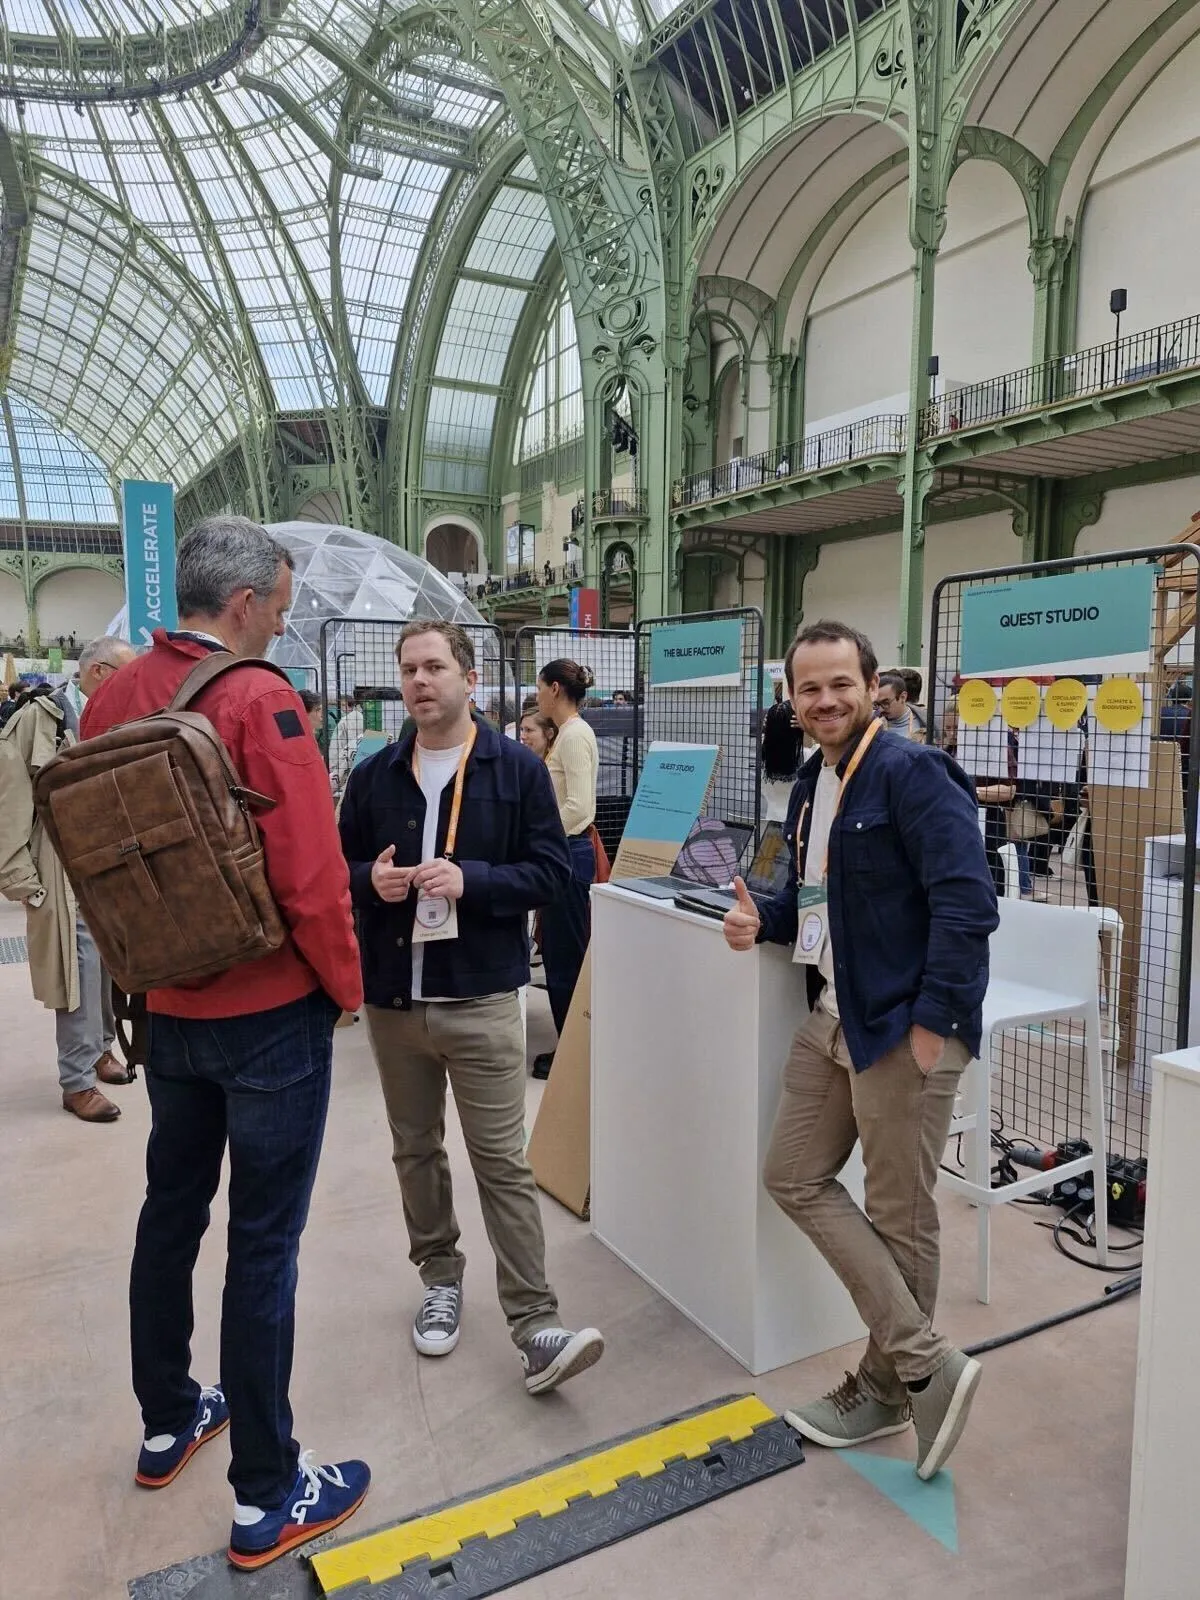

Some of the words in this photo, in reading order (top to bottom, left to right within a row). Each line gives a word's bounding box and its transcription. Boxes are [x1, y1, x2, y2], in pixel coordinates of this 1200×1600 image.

[142, 503, 161, 622] ACCELERATE
[1000, 611, 1043, 627] QUEST
[1045, 606, 1100, 624] STUDIO
[663, 649, 676, 658] THE
[676, 648, 692, 657] BLUE
[693, 645, 725, 656] FACTORY
[660, 762, 676, 770] QUEST
[675, 764, 695, 773] STUDIO
